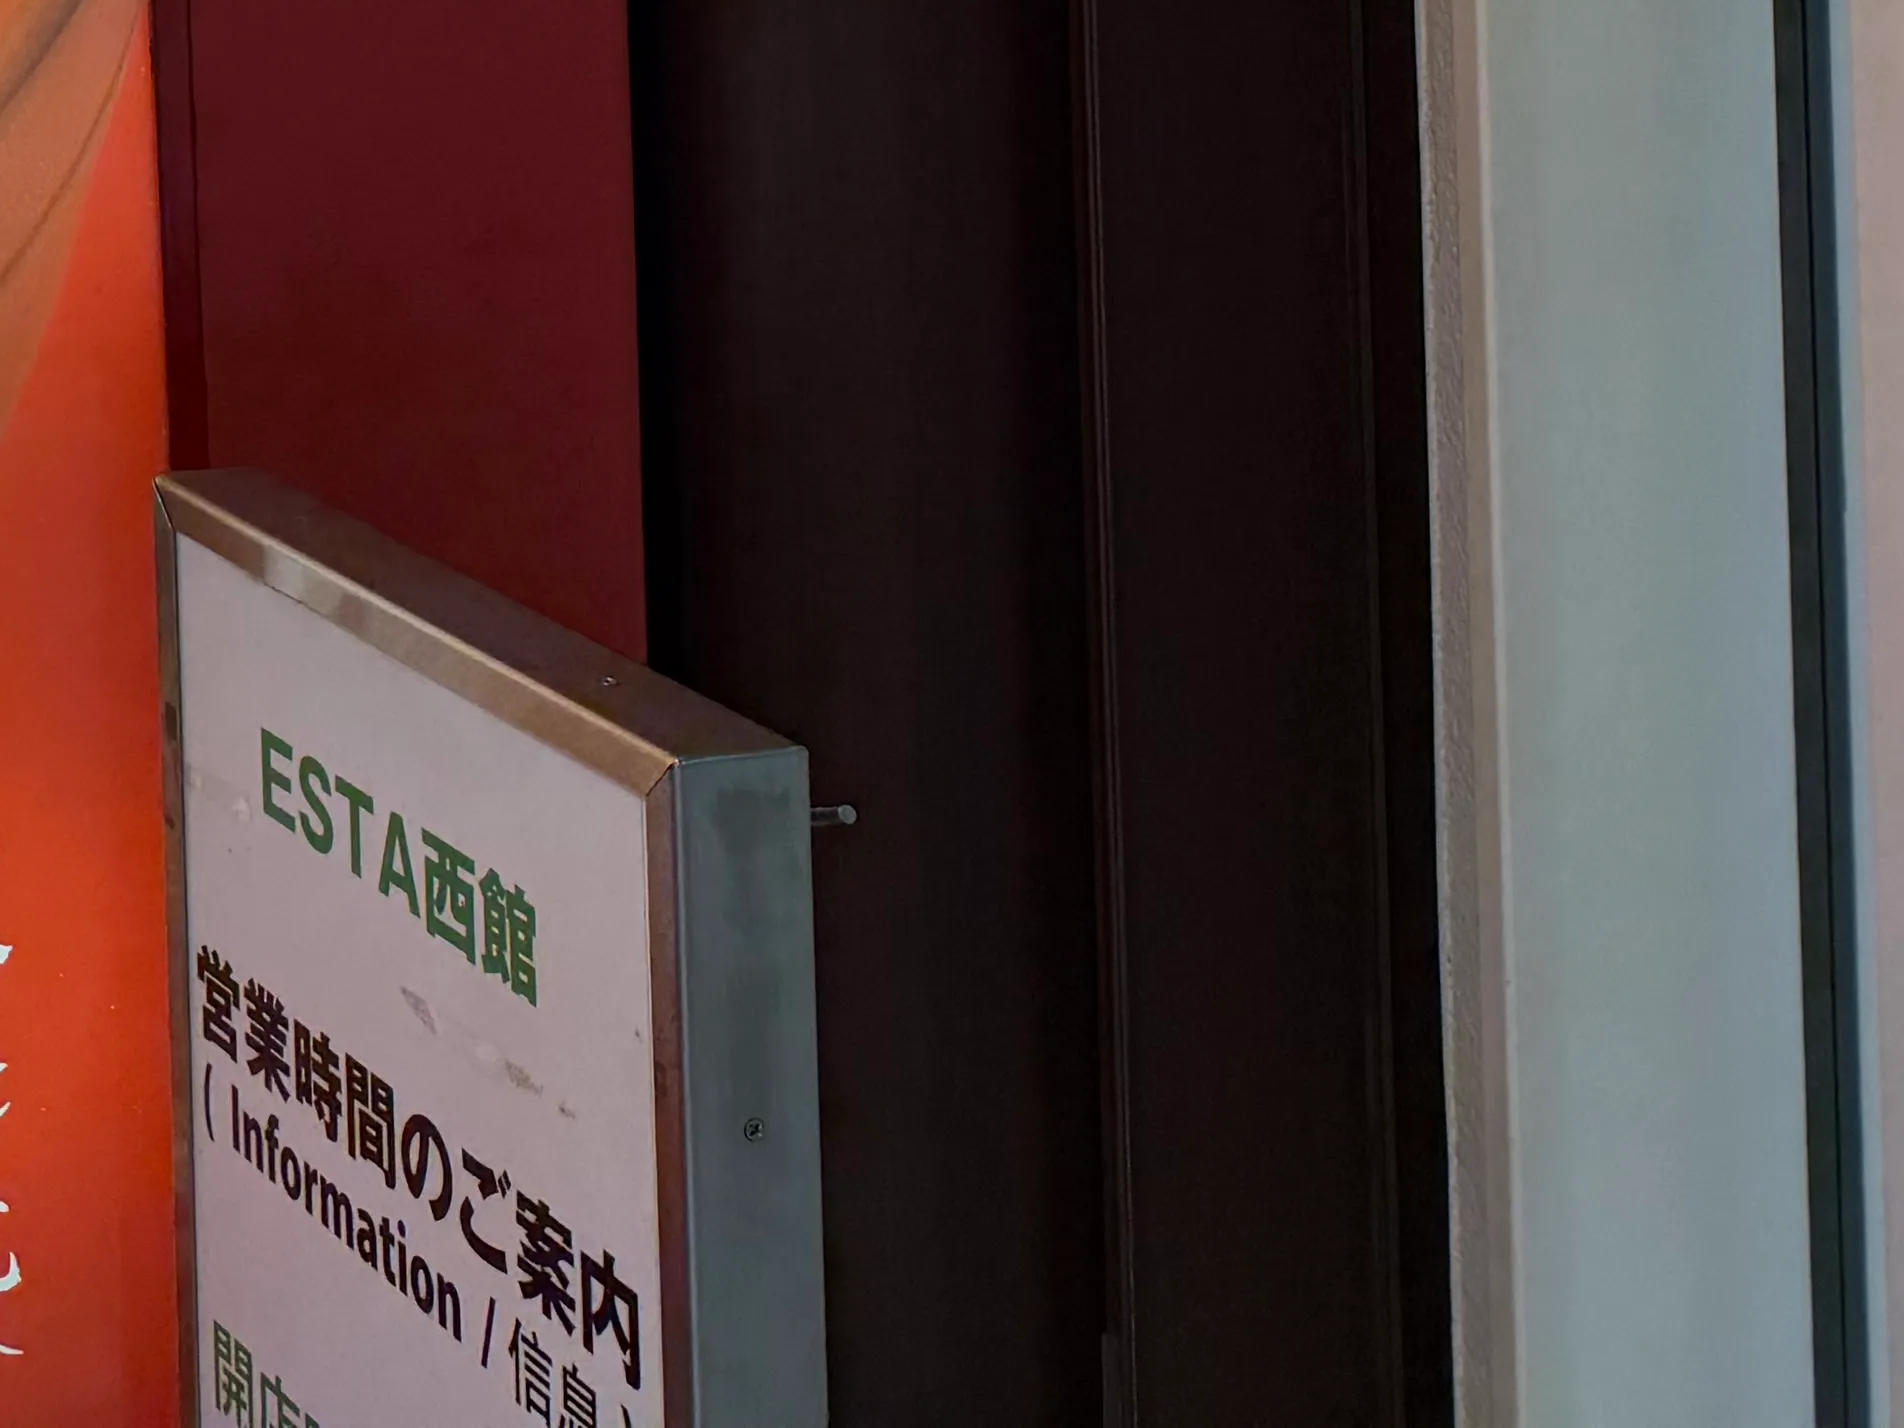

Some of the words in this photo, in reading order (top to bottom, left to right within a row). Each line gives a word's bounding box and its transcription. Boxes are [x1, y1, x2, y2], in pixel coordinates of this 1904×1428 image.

[260, 728, 538, 1008] ESTA西館
[197, 944, 642, 1390] 営業時間のご案内
[232, 1087, 463, 1344] Information
